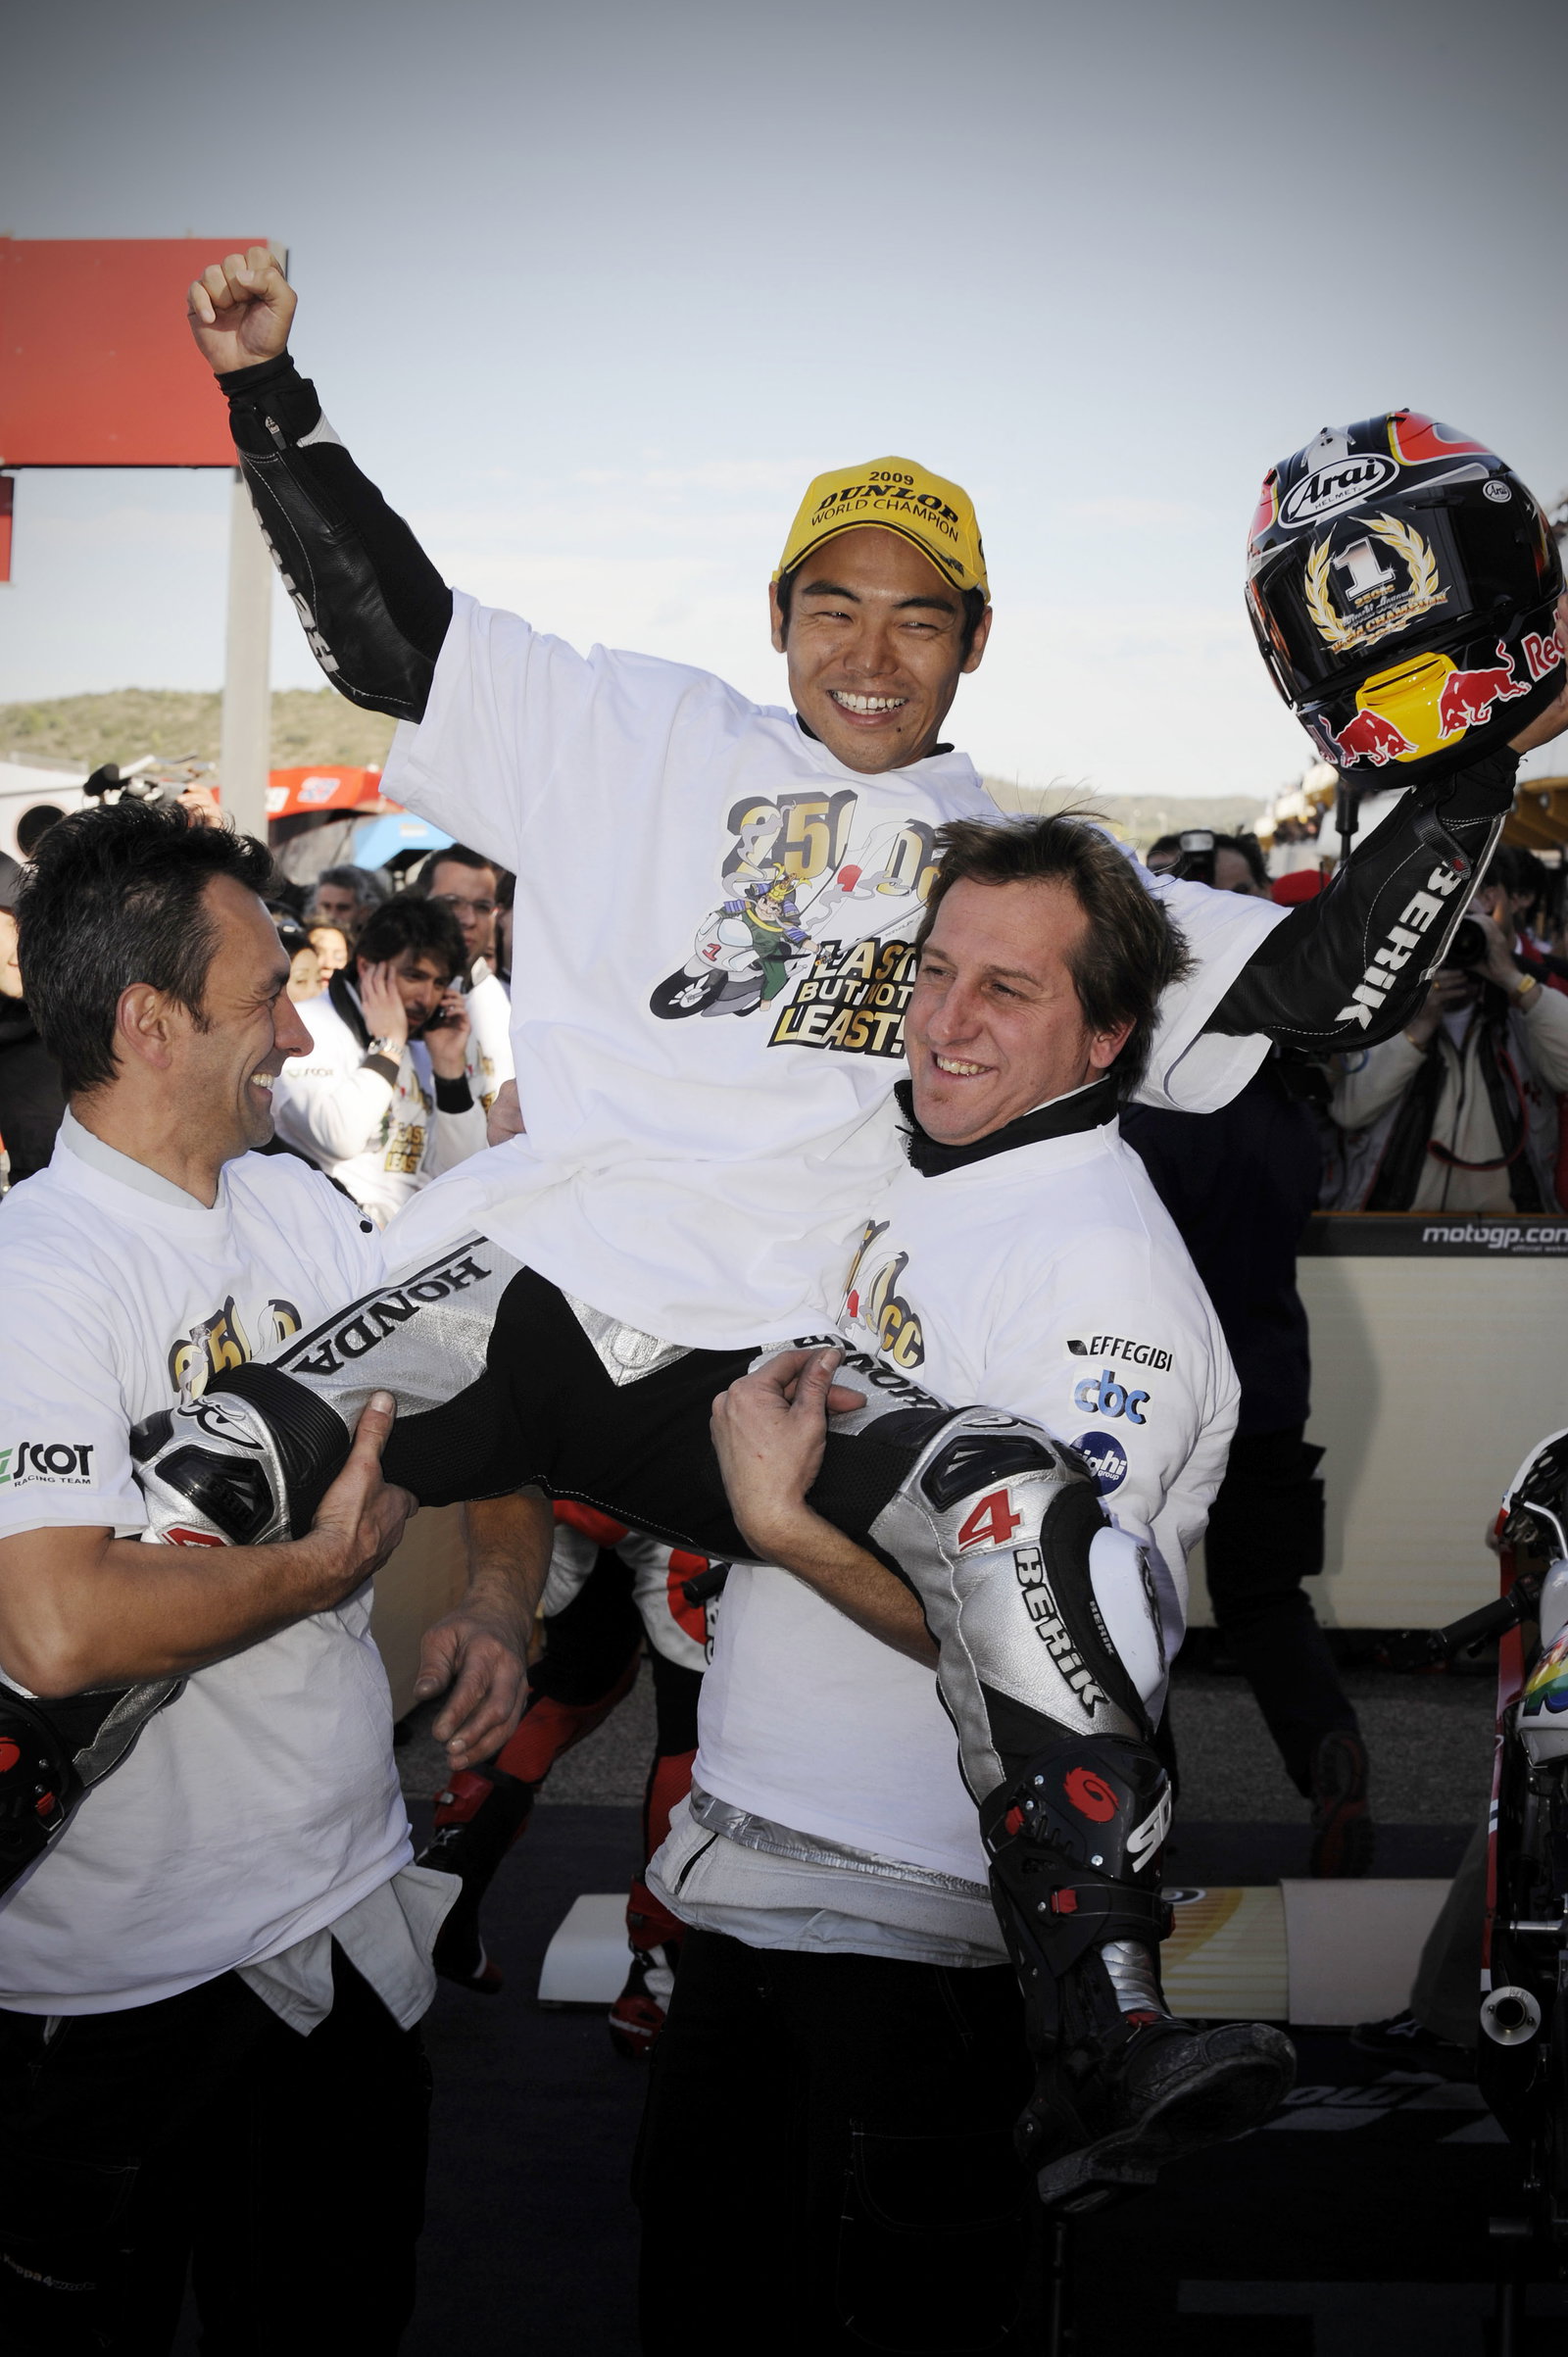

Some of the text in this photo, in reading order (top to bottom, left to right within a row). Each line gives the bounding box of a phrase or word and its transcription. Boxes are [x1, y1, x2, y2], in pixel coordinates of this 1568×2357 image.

[868, 470, 915, 486] 2009
[1288, 458, 1378, 521] Arai
[813, 484, 959, 523] DUNLOP
[1314, 486, 1359, 511] HELMET
[810, 498, 960, 543] WORLD CHAMPION
[1332, 536, 1396, 603] 1
[797, 978, 861, 1004] BUT
[291, 1255, 493, 1376] HONDA
[1088, 1335, 1174, 1372] EFFEGIBI
[1073, 1369, 1151, 1426] cbc
[14, 1442, 94, 1480] SCOT
[1097, 1469, 1120, 1481] group
[14, 1474, 91, 1488] RACING TEAM
[956, 1488, 1022, 1553] 4
